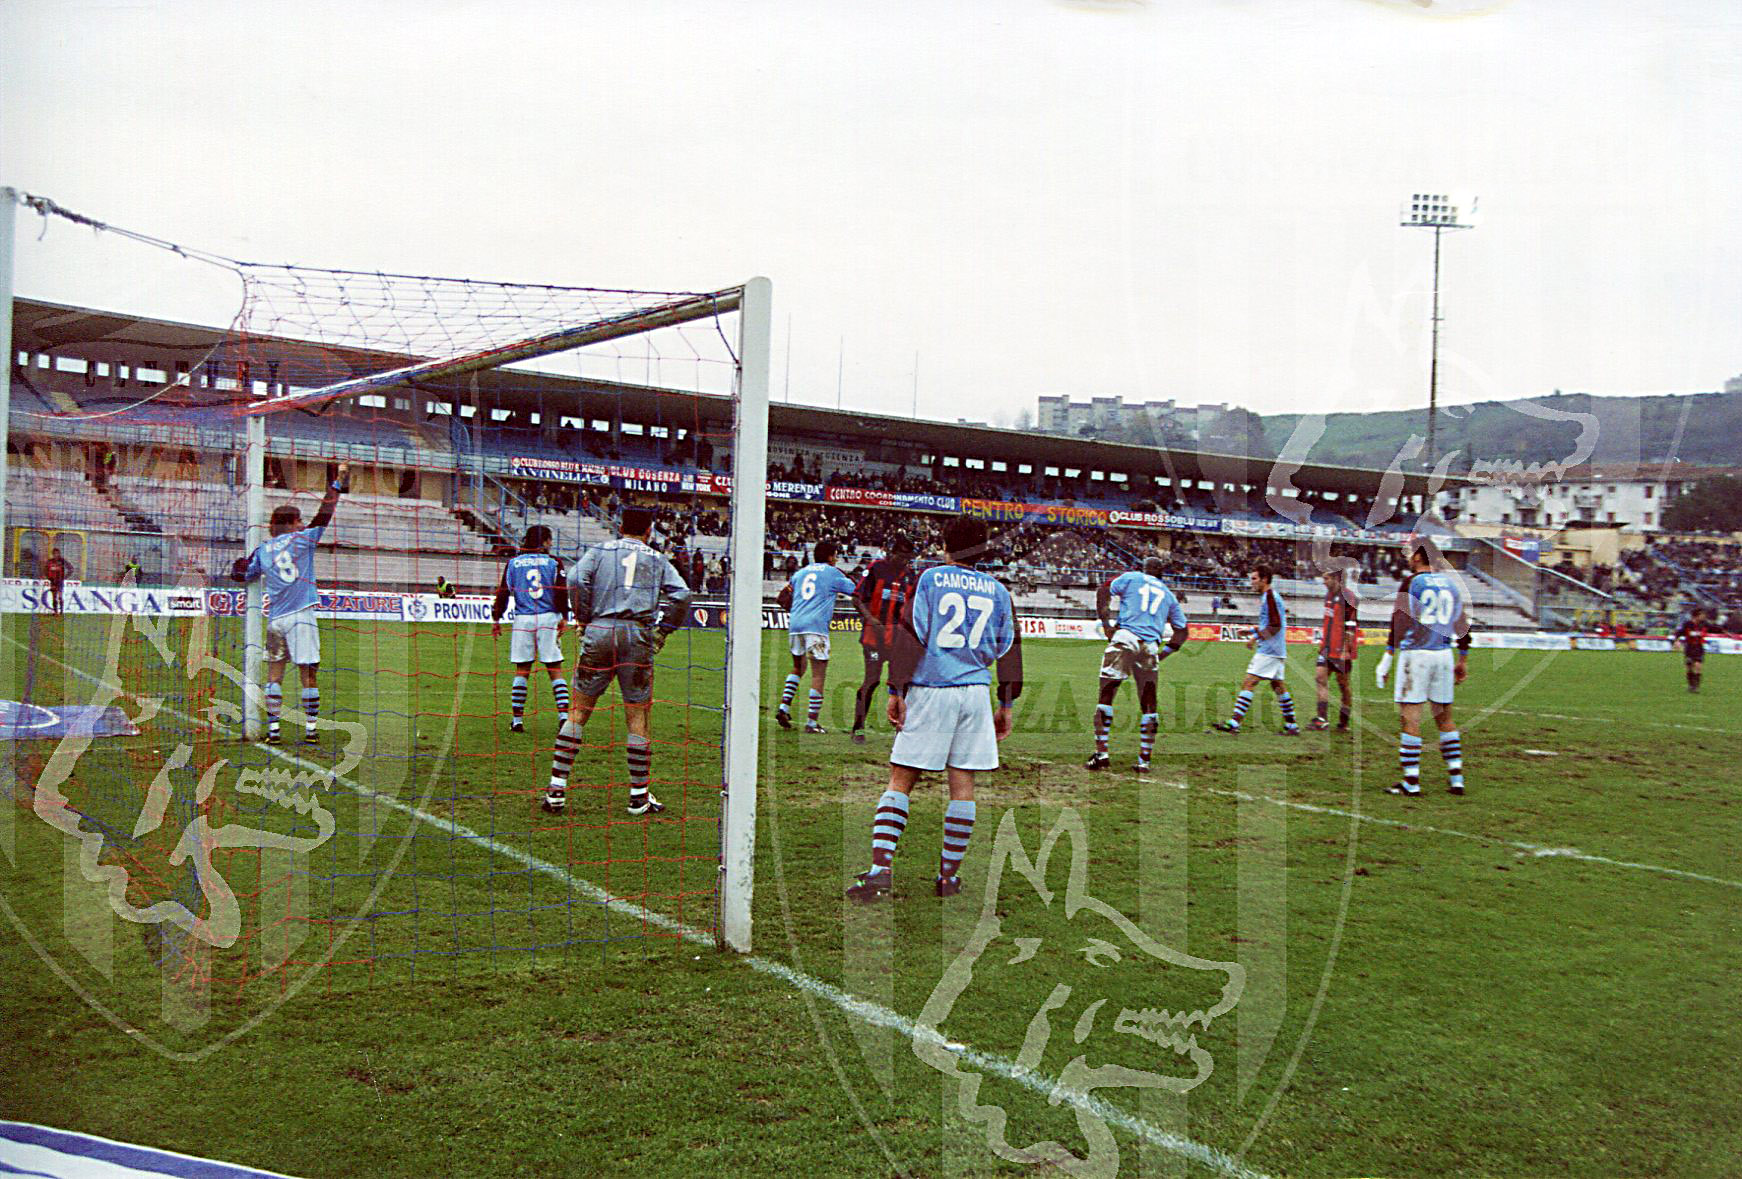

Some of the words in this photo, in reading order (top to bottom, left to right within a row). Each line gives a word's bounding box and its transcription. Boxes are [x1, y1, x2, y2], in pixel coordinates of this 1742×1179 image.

[610, 466, 635, 478] CLUB
[638, 469, 680, 482] COSENZA
[625, 479, 668, 492] MILANO
[715, 476, 736, 487] CLU
[864, 491, 934, 506] COORDINAMENTO
[961, 498, 1024, 521] CENTRO
[1047, 506, 1107, 527] STORICO
[1120, 511, 1143, 522] CLUB
[275, 550, 299, 583] 8
[621, 550, 637, 590] 1
[526, 569, 543, 599] 3
[801, 573, 817, 601] 6
[934, 572, 995, 595] CAMORANI
[170, 600, 201, 610] smart
[313, 596, 400, 613] LZATURE
[1138, 583, 1165, 615] 17
[1420, 589, 1454, 625] 20
[434, 603, 505, 621] PROVINC
[936, 592, 994, 650] 27
